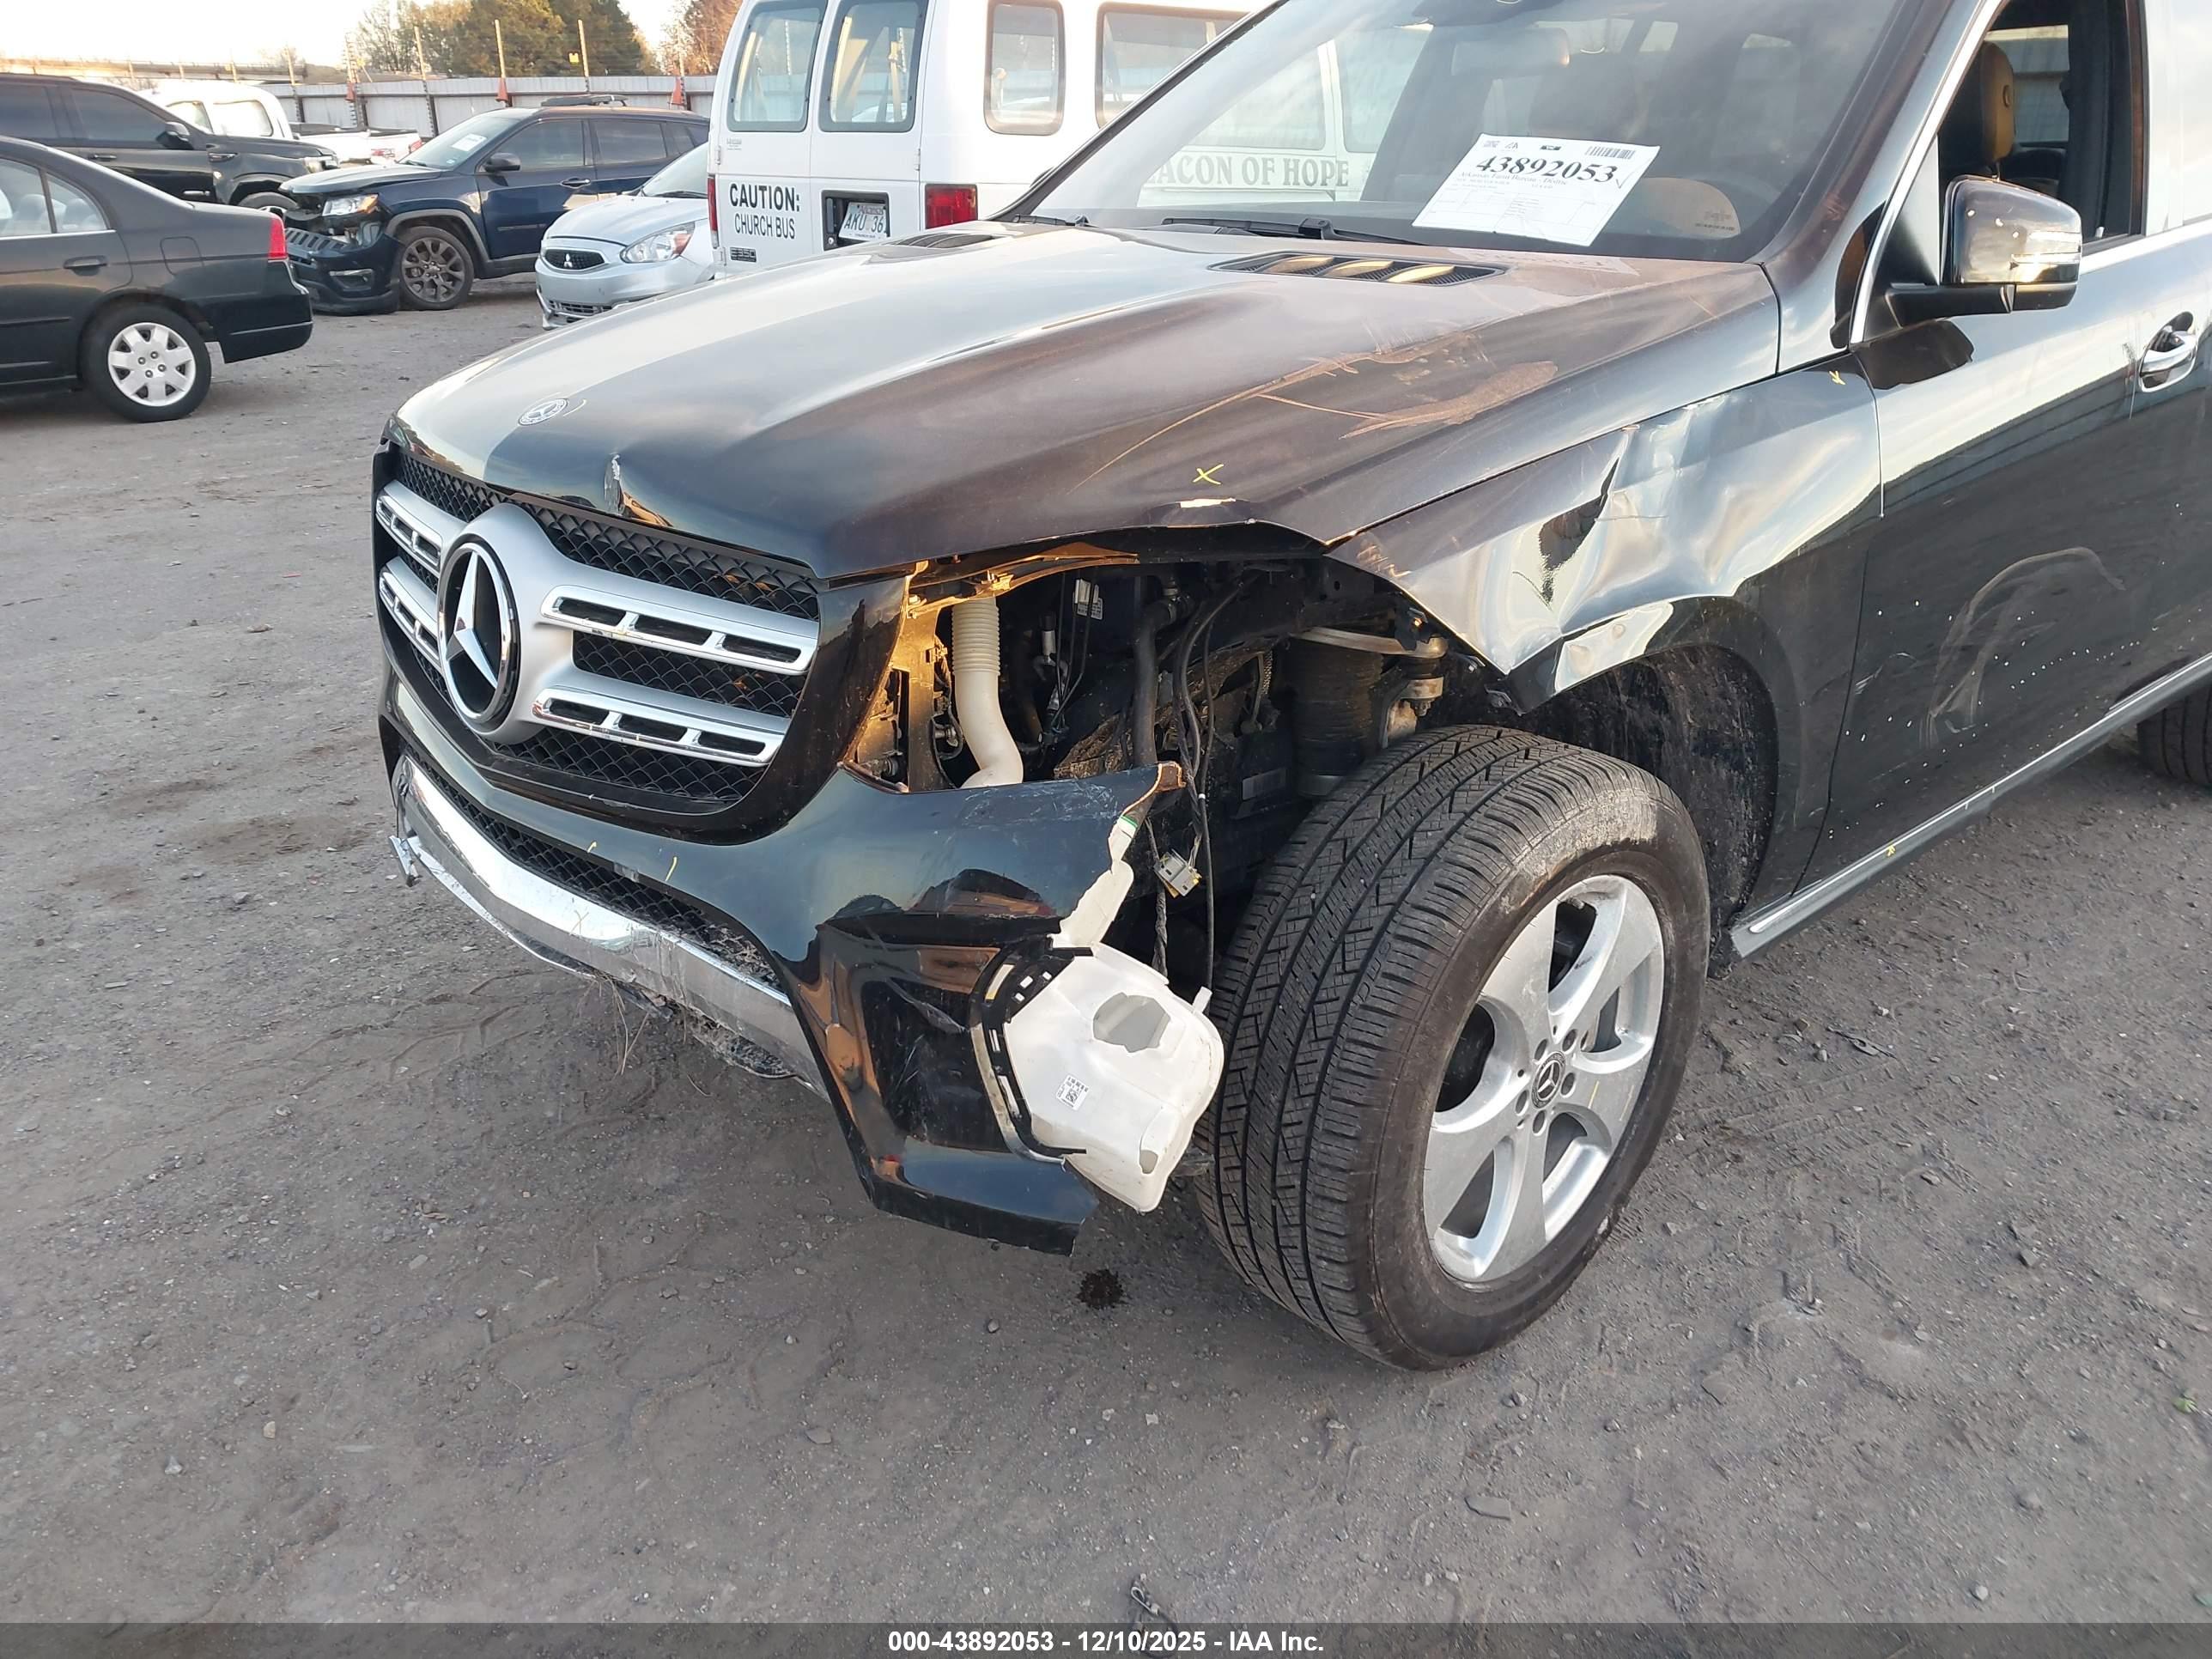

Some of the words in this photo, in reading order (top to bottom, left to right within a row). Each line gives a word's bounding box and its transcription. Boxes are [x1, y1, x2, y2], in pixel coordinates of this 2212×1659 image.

[1242, 156, 1275, 185] OF
[1283, 158, 1349, 186] HOPE
[1476, 155, 1618, 183] 43892053
[730, 183, 799, 212] CAUTION:
[734, 213, 773, 236] CHURCH
[775, 216, 795, 239] BUS
[844, 213, 866, 230] AKU
[872, 216, 886, 233] 36
[731, 247, 756, 258] E350
